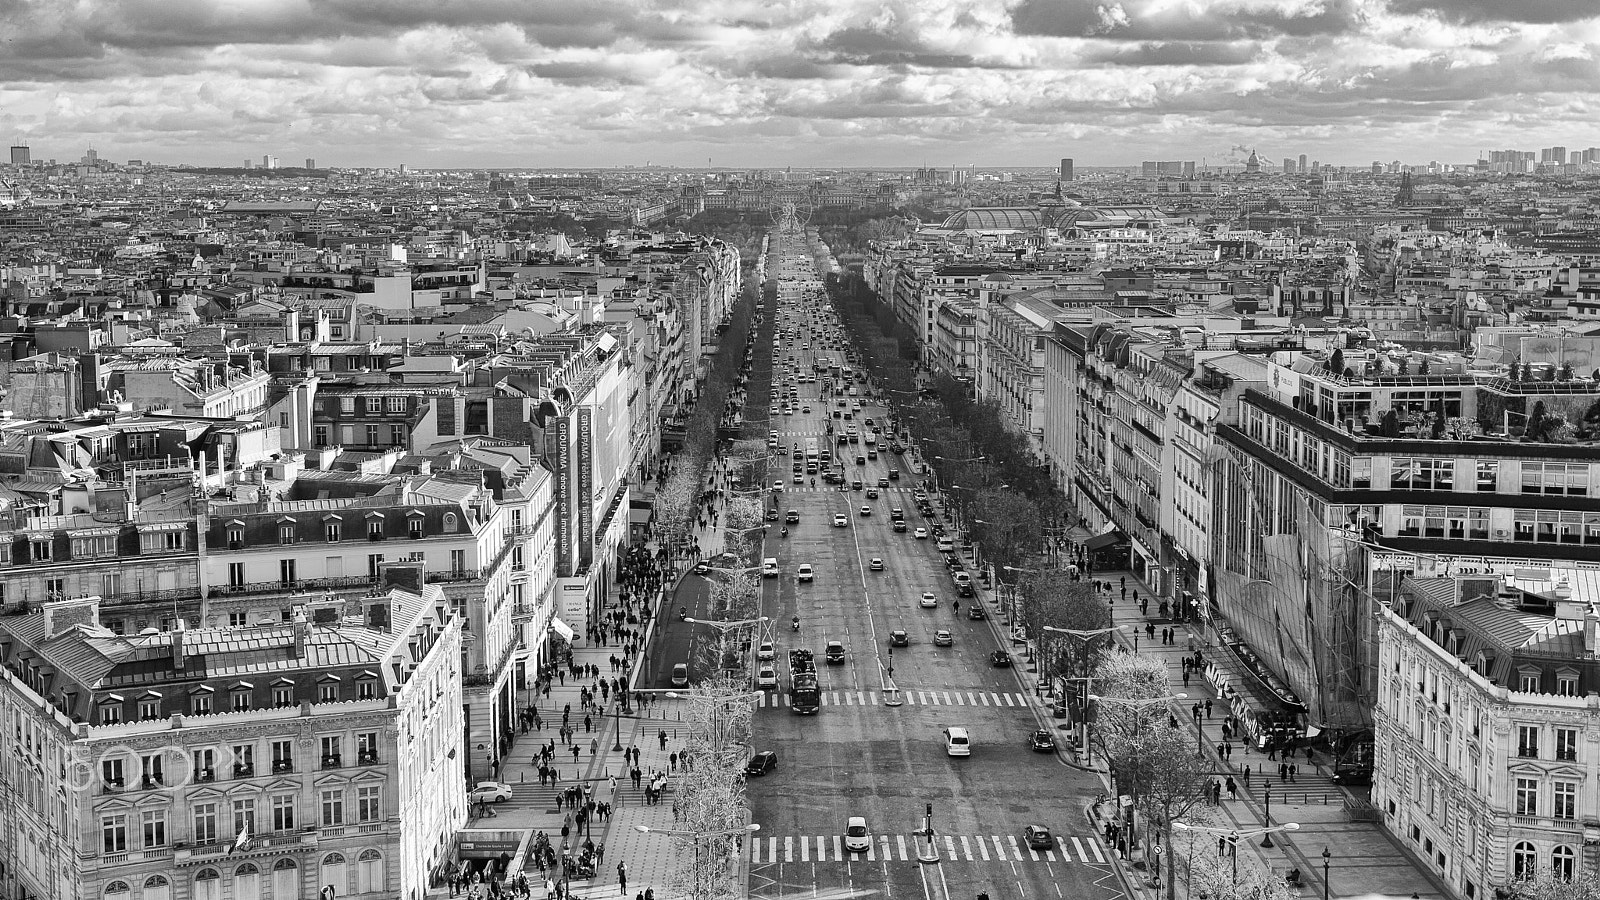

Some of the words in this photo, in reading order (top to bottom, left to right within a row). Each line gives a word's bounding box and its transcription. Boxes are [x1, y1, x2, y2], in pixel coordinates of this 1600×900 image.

[559, 422, 567, 469] GROUPAMA
[581, 414, 589, 460] GROUPAMA
[560, 472, 568, 499] rénove
[581, 462, 589, 488] rénove
[560, 502, 568, 515] cet
[560, 518, 568, 555] immeuble
